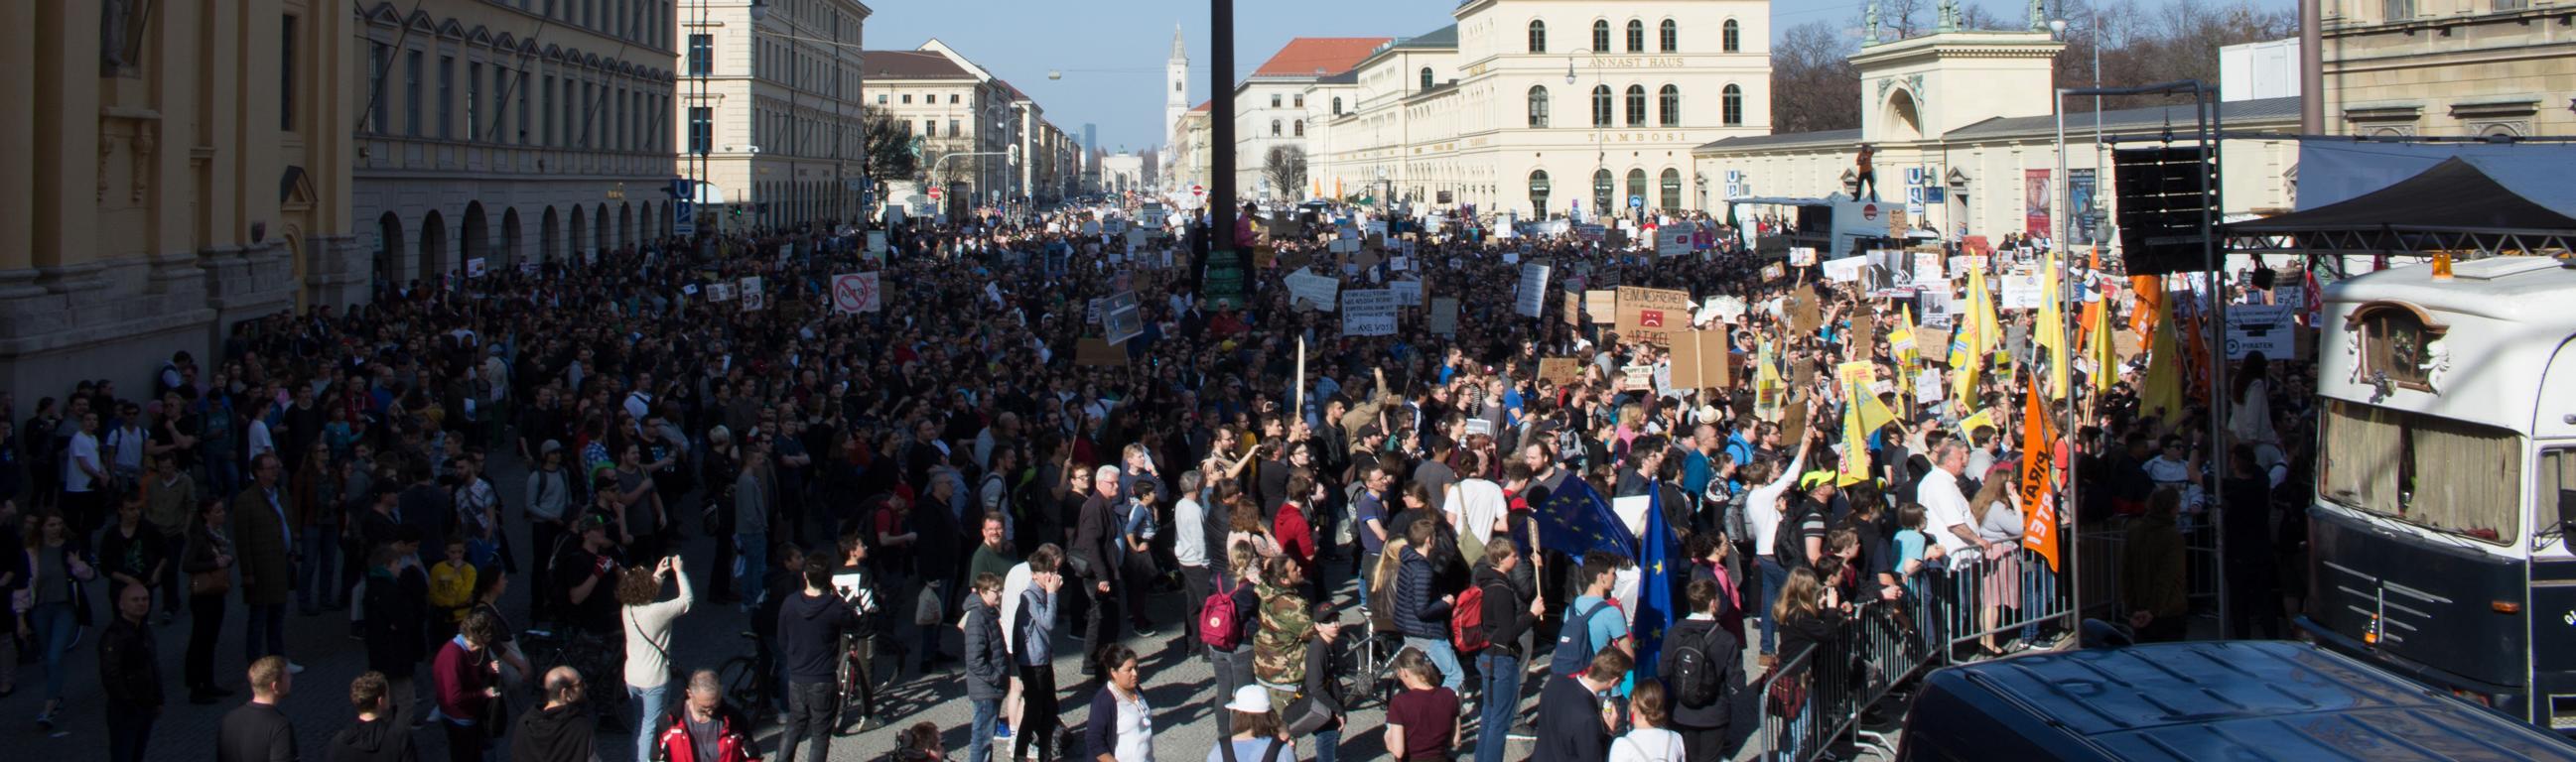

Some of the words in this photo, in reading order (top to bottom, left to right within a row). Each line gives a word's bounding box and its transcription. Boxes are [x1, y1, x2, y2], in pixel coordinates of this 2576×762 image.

[1588, 58, 1642, 67] ANNAST
[1650, 58, 1685, 67] HAUS
[1588, 133, 1686, 142] TAMBOSI
[1727, 170, 1738, 183] U
[1908, 169, 1922, 184] U
[676, 180, 692, 198] U
[1626, 329, 1670, 346] ARTIKEL
